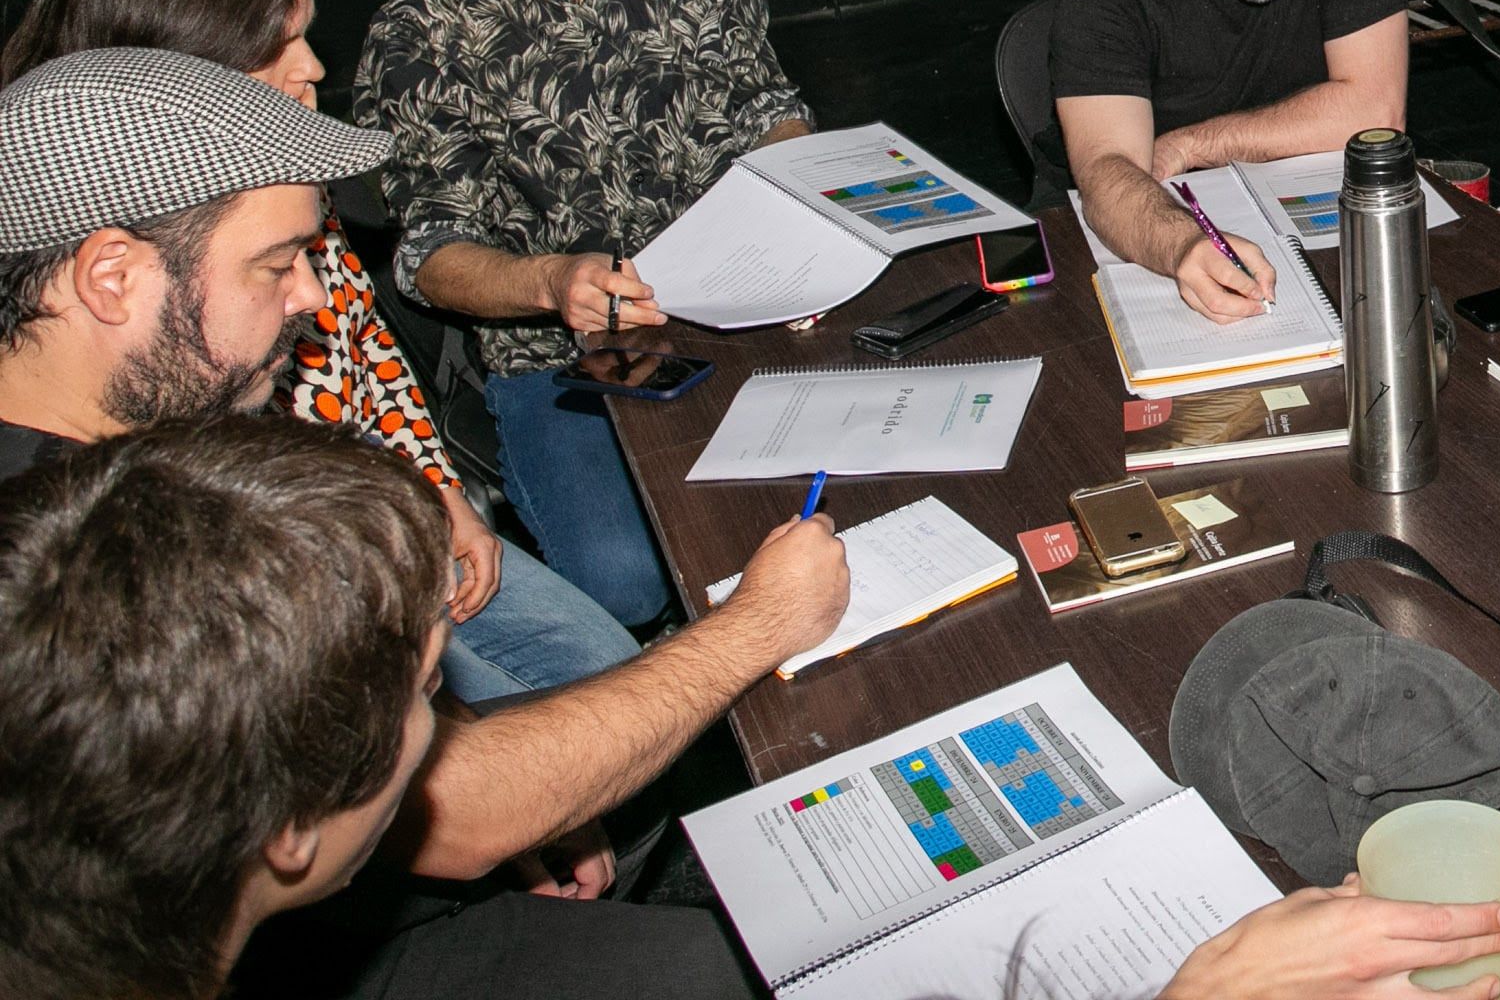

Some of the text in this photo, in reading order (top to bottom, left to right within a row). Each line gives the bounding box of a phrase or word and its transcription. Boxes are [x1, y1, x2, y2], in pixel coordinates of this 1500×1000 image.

[881, 387, 913, 436] Podrido
[1035, 717, 1059, 739] OCTUBRE
[948, 749, 974, 776] DICIEMBRE
[1076, 764, 1106, 794] NOVIEMBRE
[992, 808, 1012, 827] ENERO
[1197, 894, 1224, 924] Podrido
